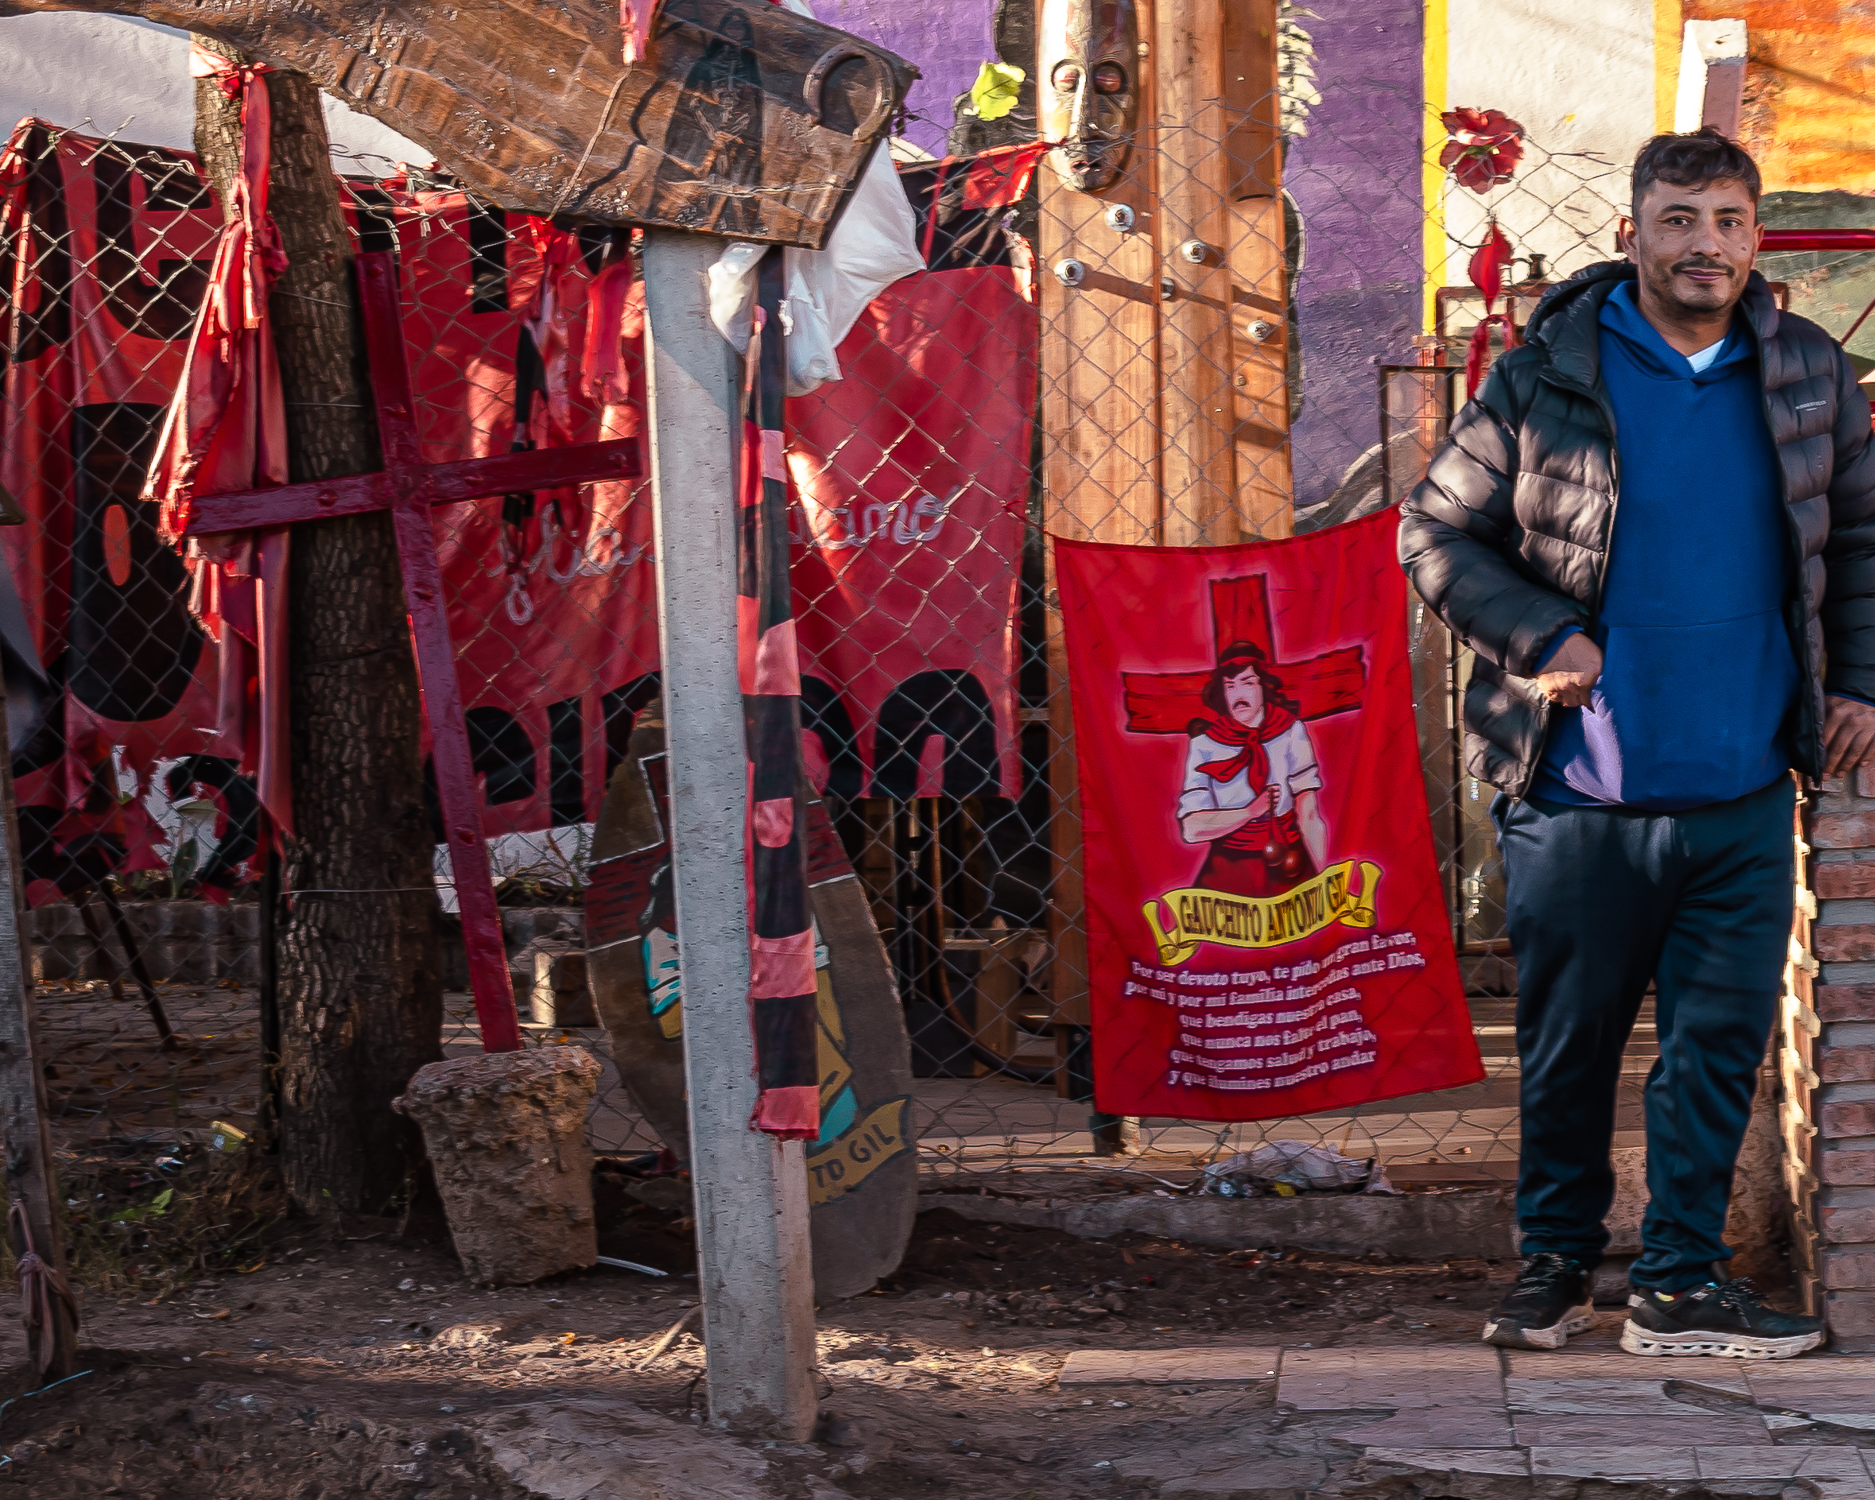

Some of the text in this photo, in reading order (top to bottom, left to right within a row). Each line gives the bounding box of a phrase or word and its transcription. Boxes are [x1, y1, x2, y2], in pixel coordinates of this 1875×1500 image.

[1180, 872, 1348, 942] GAUCHITO ANTONIO GIL
[1178, 969, 1229, 986] devoto
[1272, 966, 1290, 979] te
[1335, 940, 1370, 963] gran
[1228, 986, 1284, 1006] familia
[1351, 959, 1386, 976] ante
[1179, 1014, 1203, 1028] que
[1204, 1011, 1274, 1029] bendigas
[1170, 1049, 1195, 1063] que
[1195, 1054, 1264, 1073] tengamos
[1265, 1046, 1306, 1068] salud
[1180, 1032, 1203, 1046] que
[1204, 1036, 1252, 1049] nunca
[1253, 1034, 1281, 1047] nos
[1167, 1070, 1181, 1085] y
[1181, 1071, 1206, 1086] que
[1273, 1061, 1330, 1088] nuestro
[1330, 1050, 1377, 1071] andar
[849, 1123, 896, 1164] GIL
